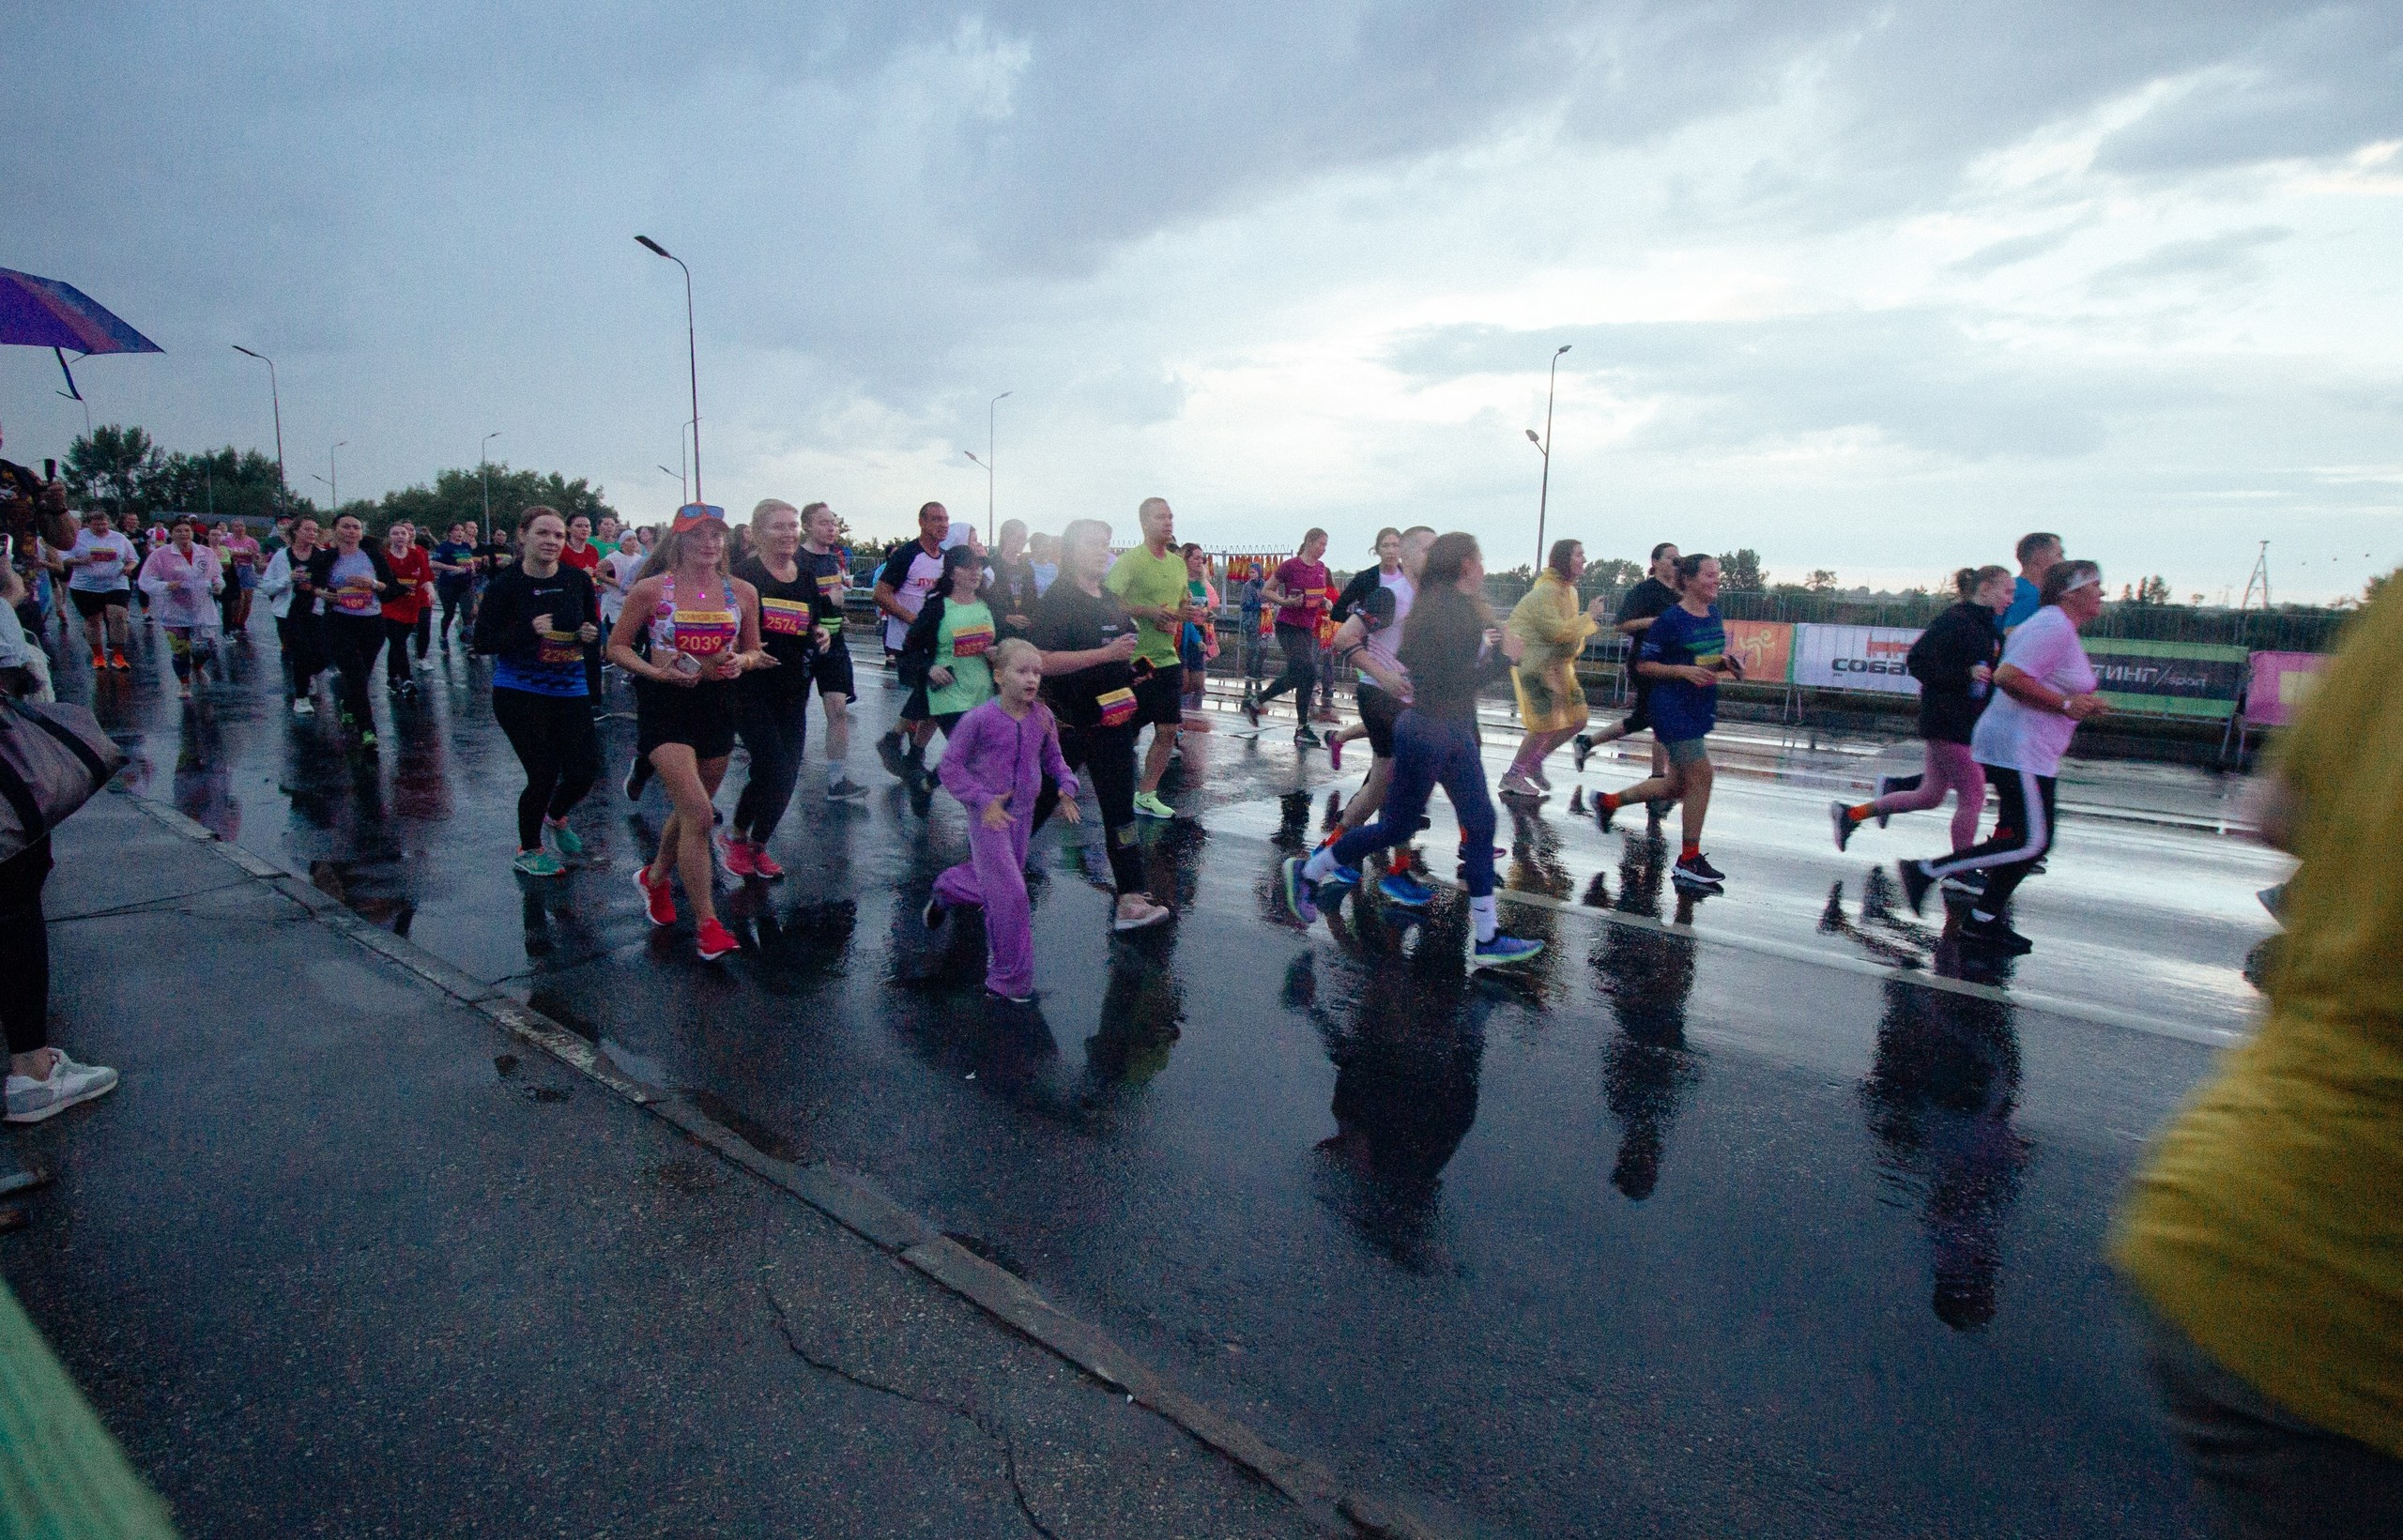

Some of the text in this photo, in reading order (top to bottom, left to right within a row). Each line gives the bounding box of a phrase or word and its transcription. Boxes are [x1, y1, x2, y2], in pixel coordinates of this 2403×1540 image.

[917, 578, 937, 589] ЛУ
[765, 616, 797, 632] 2574
[678, 635, 722, 650] 2039
